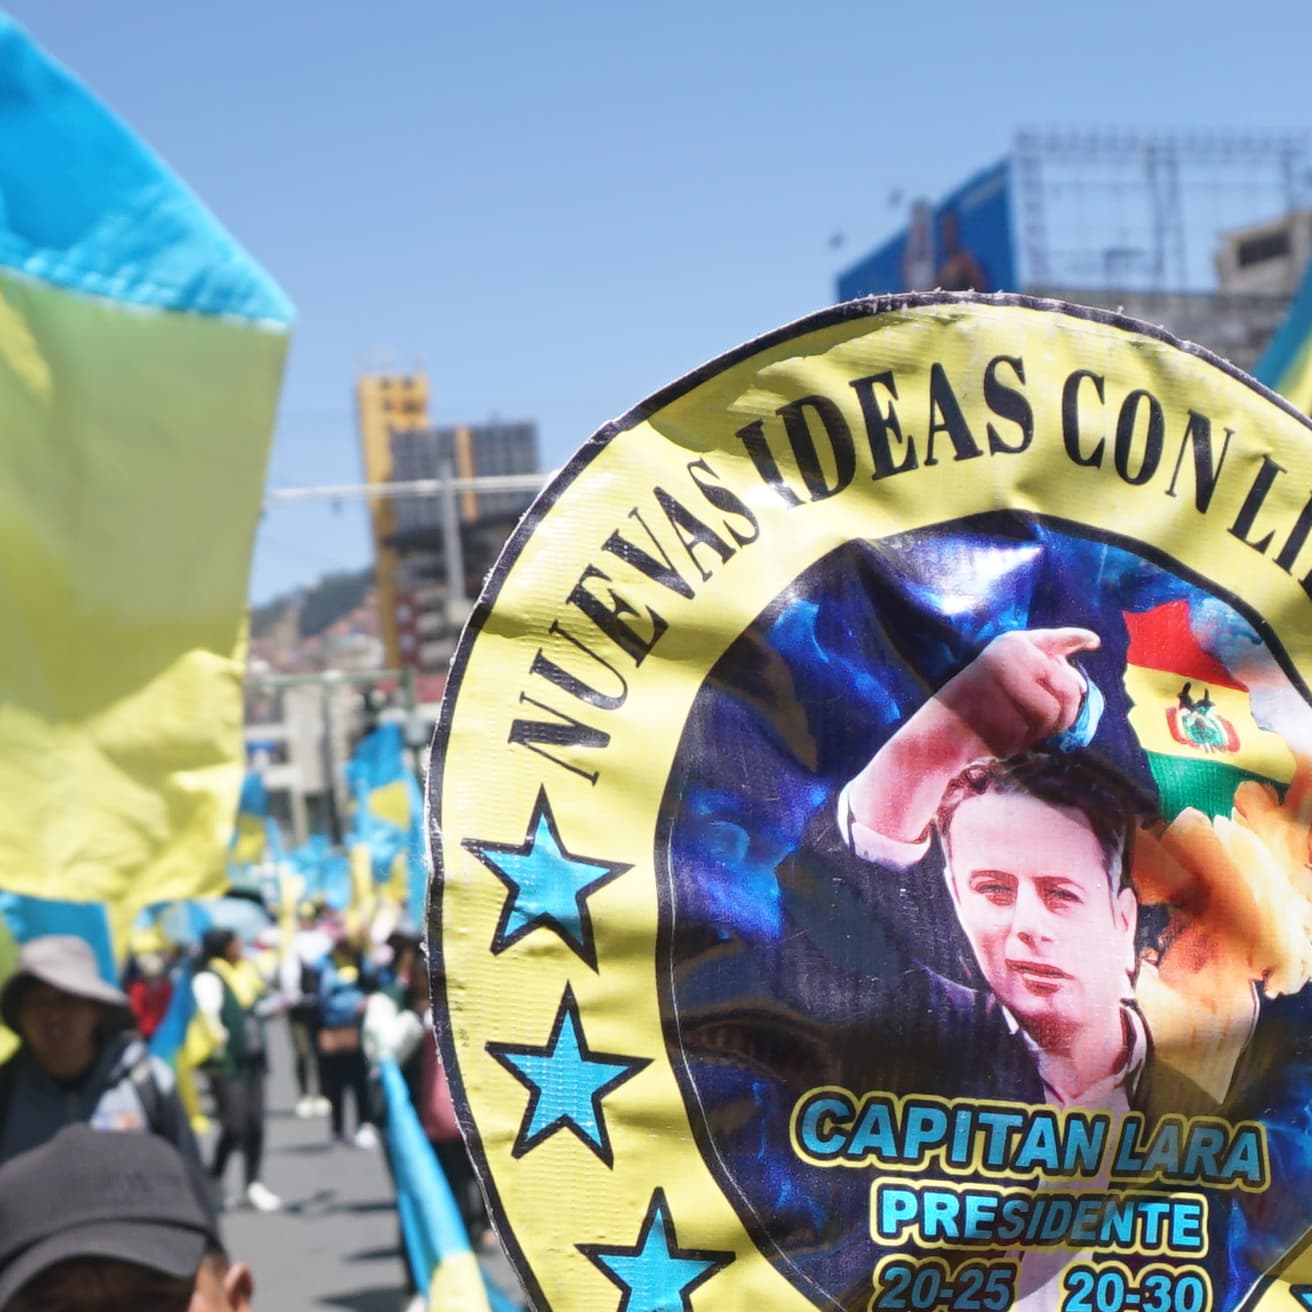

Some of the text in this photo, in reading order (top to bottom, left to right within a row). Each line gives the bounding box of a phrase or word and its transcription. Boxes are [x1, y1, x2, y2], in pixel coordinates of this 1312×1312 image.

[508, 458, 761, 786] NUEVAS
[735, 355, 1034, 508] IDEAS
[1062, 369, 1236, 514] CON
[796, 1096, 1267, 1184] CAPITAN LARA
[876, 1186, 1205, 1249] PRESIDENTE
